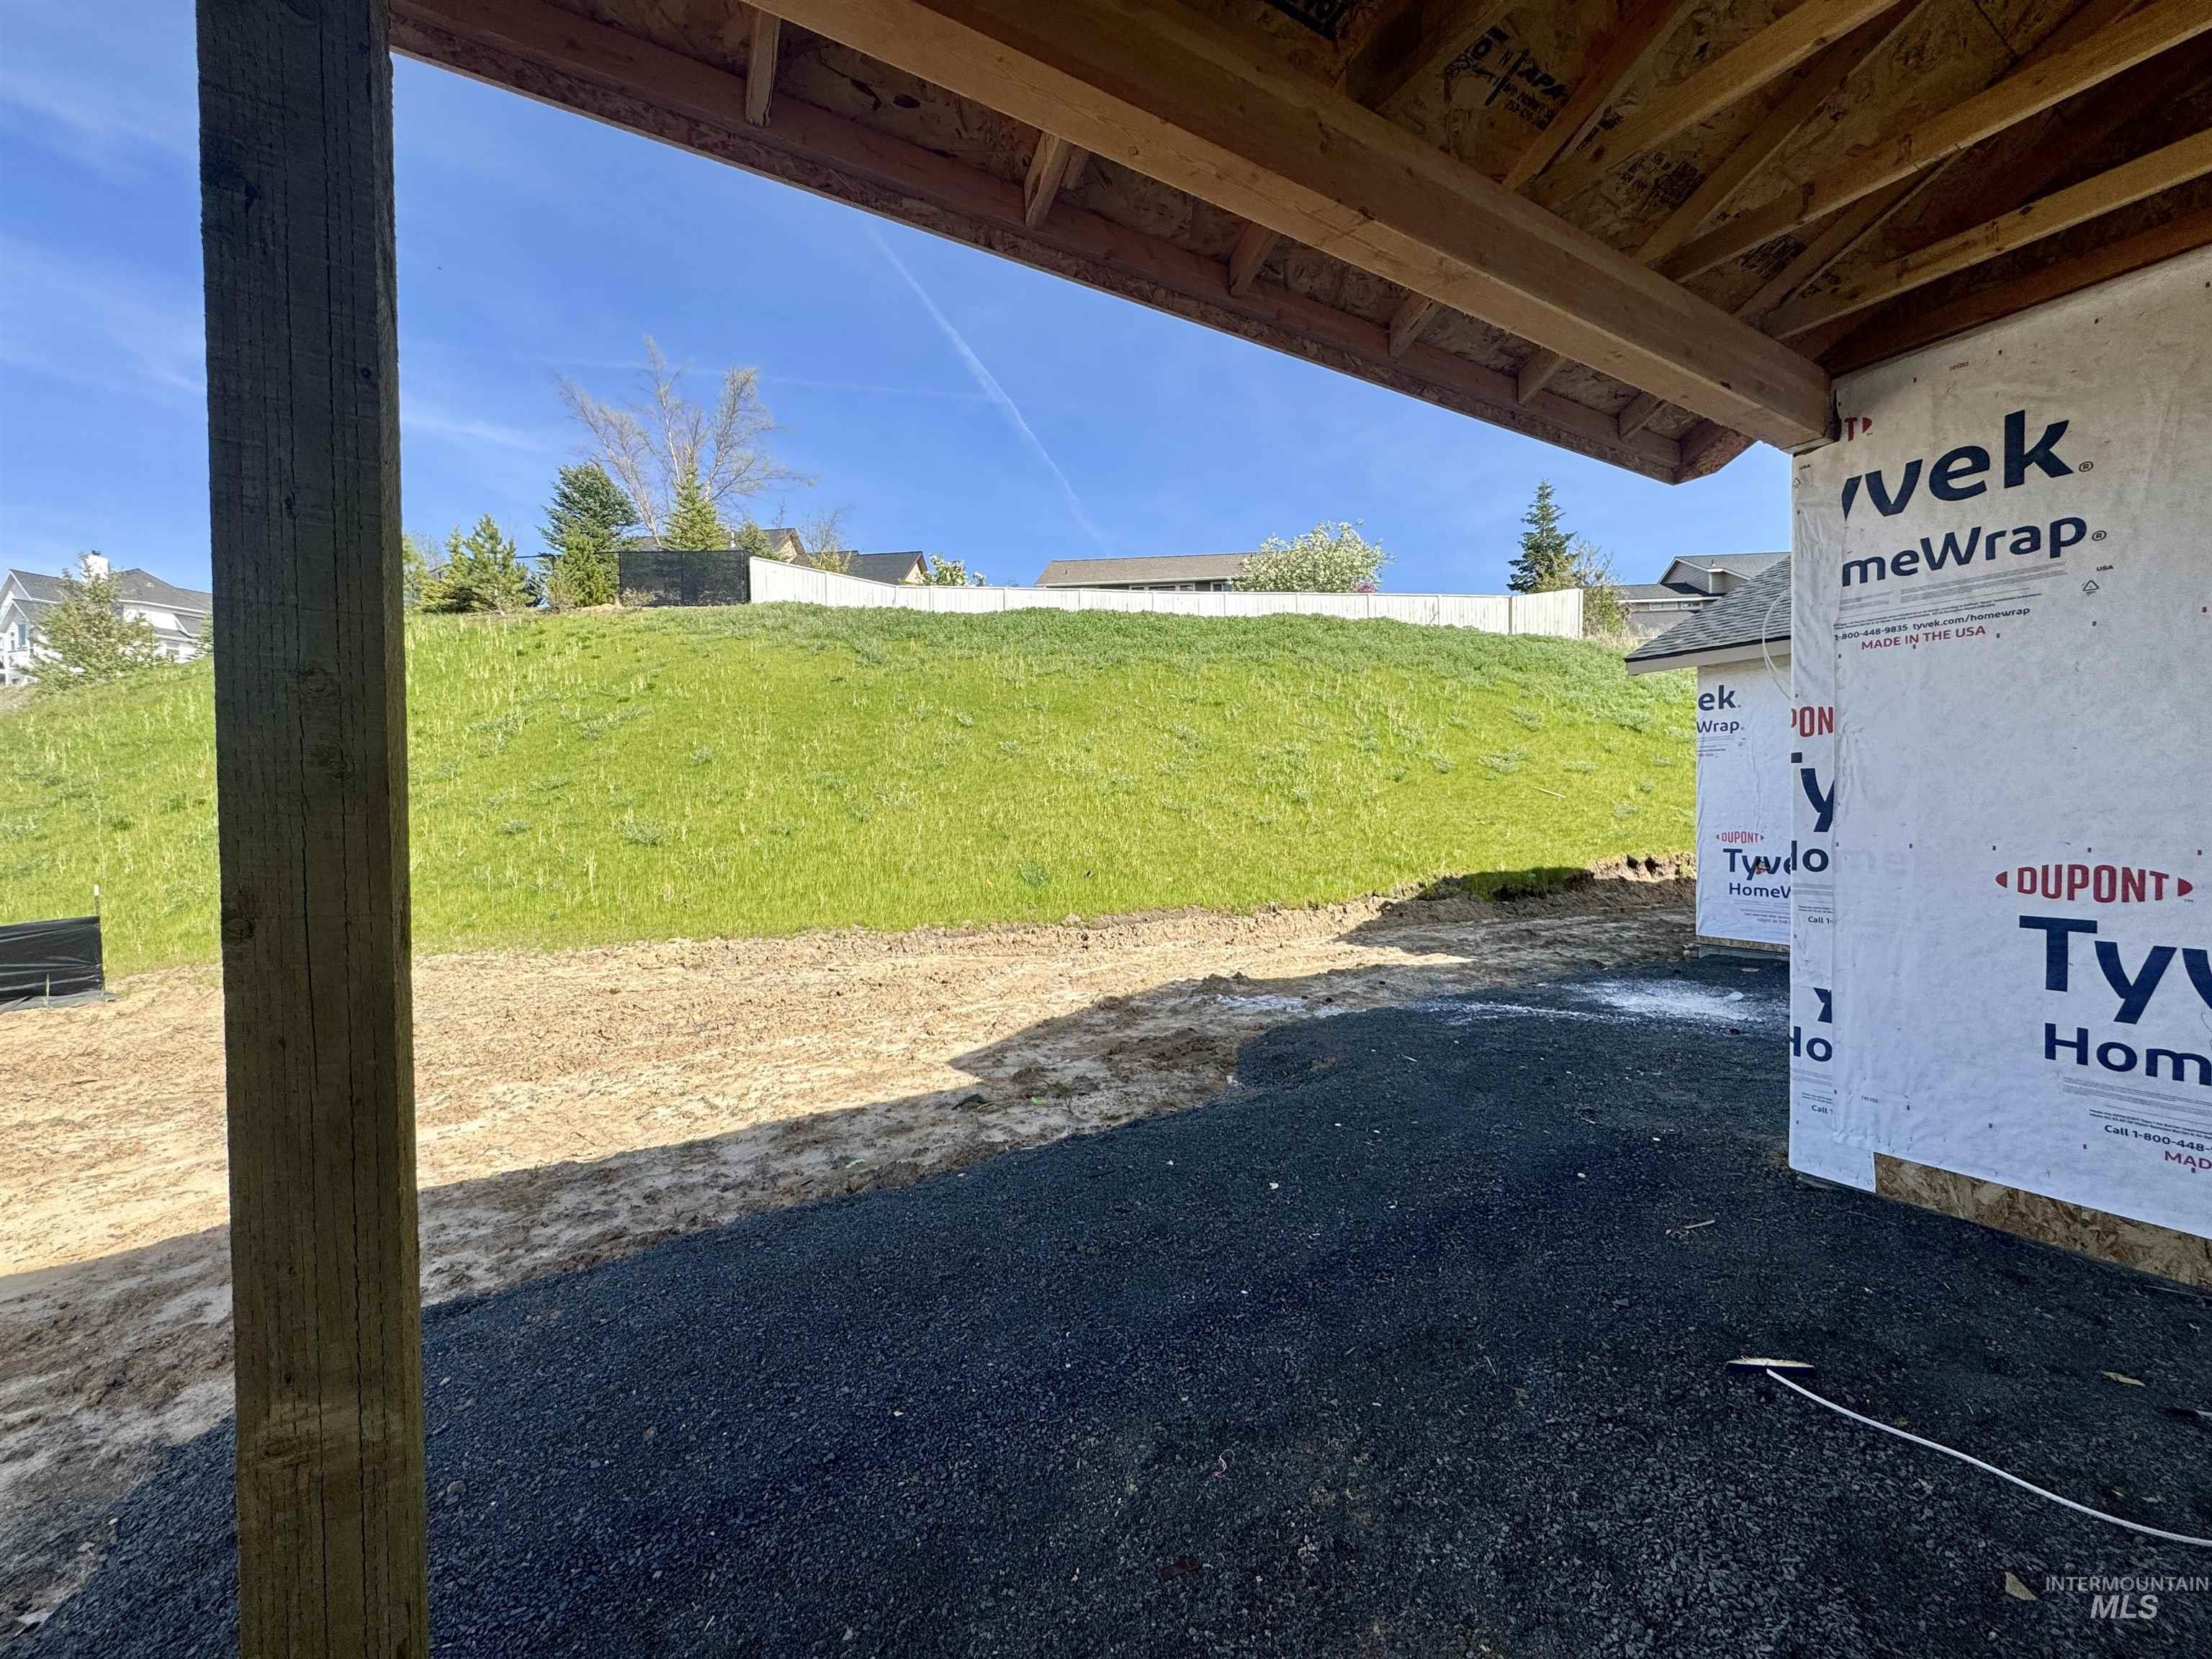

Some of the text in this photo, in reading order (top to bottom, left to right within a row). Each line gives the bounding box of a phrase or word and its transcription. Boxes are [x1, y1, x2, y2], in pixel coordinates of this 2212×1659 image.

[1841, 516, 2087, 588] meWrap
[1912, 606, 2031, 631] tyvek.com/homewrap
[1861, 624, 1987, 650] MADE IN THE USA
[1699, 685, 1736, 711] ek
[1696, 720, 1740, 734] Wrap
[1722, 831, 1759, 844] DUPONT
[2017, 863, 2170, 904] DUPONT
[1812, 1105, 1828, 1115] Call
[2104, 1124, 2129, 1137] Call
